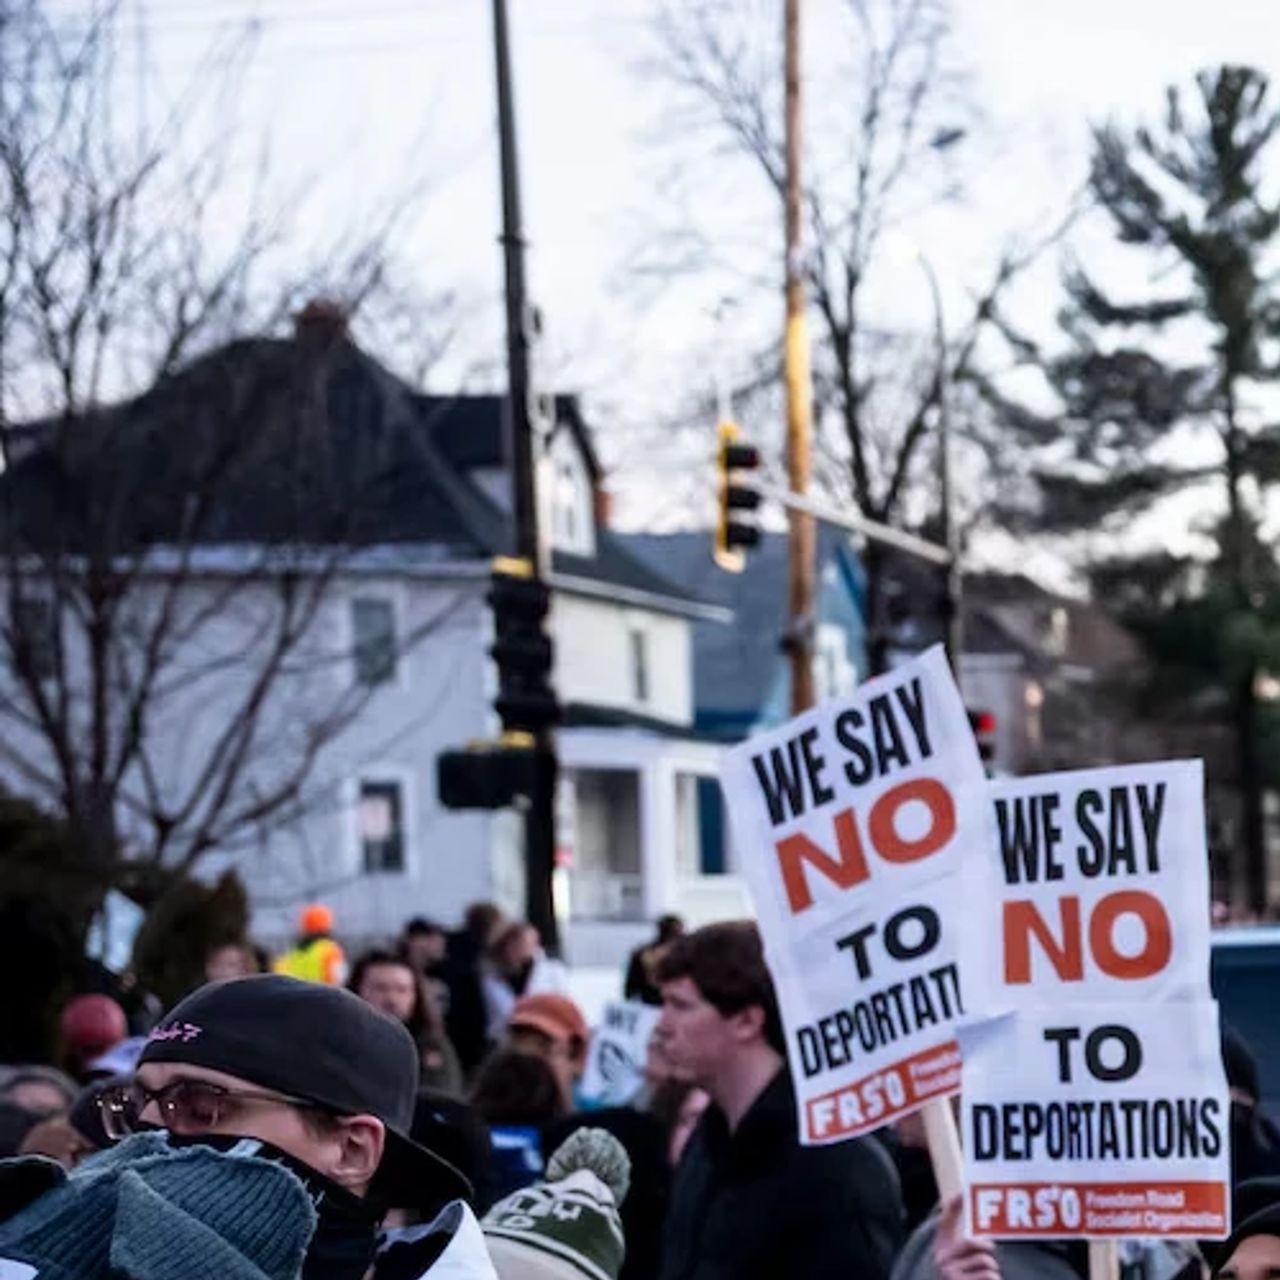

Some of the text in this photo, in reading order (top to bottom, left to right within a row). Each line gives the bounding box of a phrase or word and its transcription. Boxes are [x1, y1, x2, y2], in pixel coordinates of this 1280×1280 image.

[752, 677, 932, 827] WE SAY
[775, 777, 956, 916] NO
[994, 782, 1166, 884] WE SAY
[836, 905, 941, 981] TO
[1003, 889, 1173, 985] NO
[1043, 1024, 1143, 1083] TO
[811, 1067, 906, 1136] FRSO
[972, 1097, 1221, 1161] DEPORTATIONS
[976, 1186, 1081, 1229] FRSO
